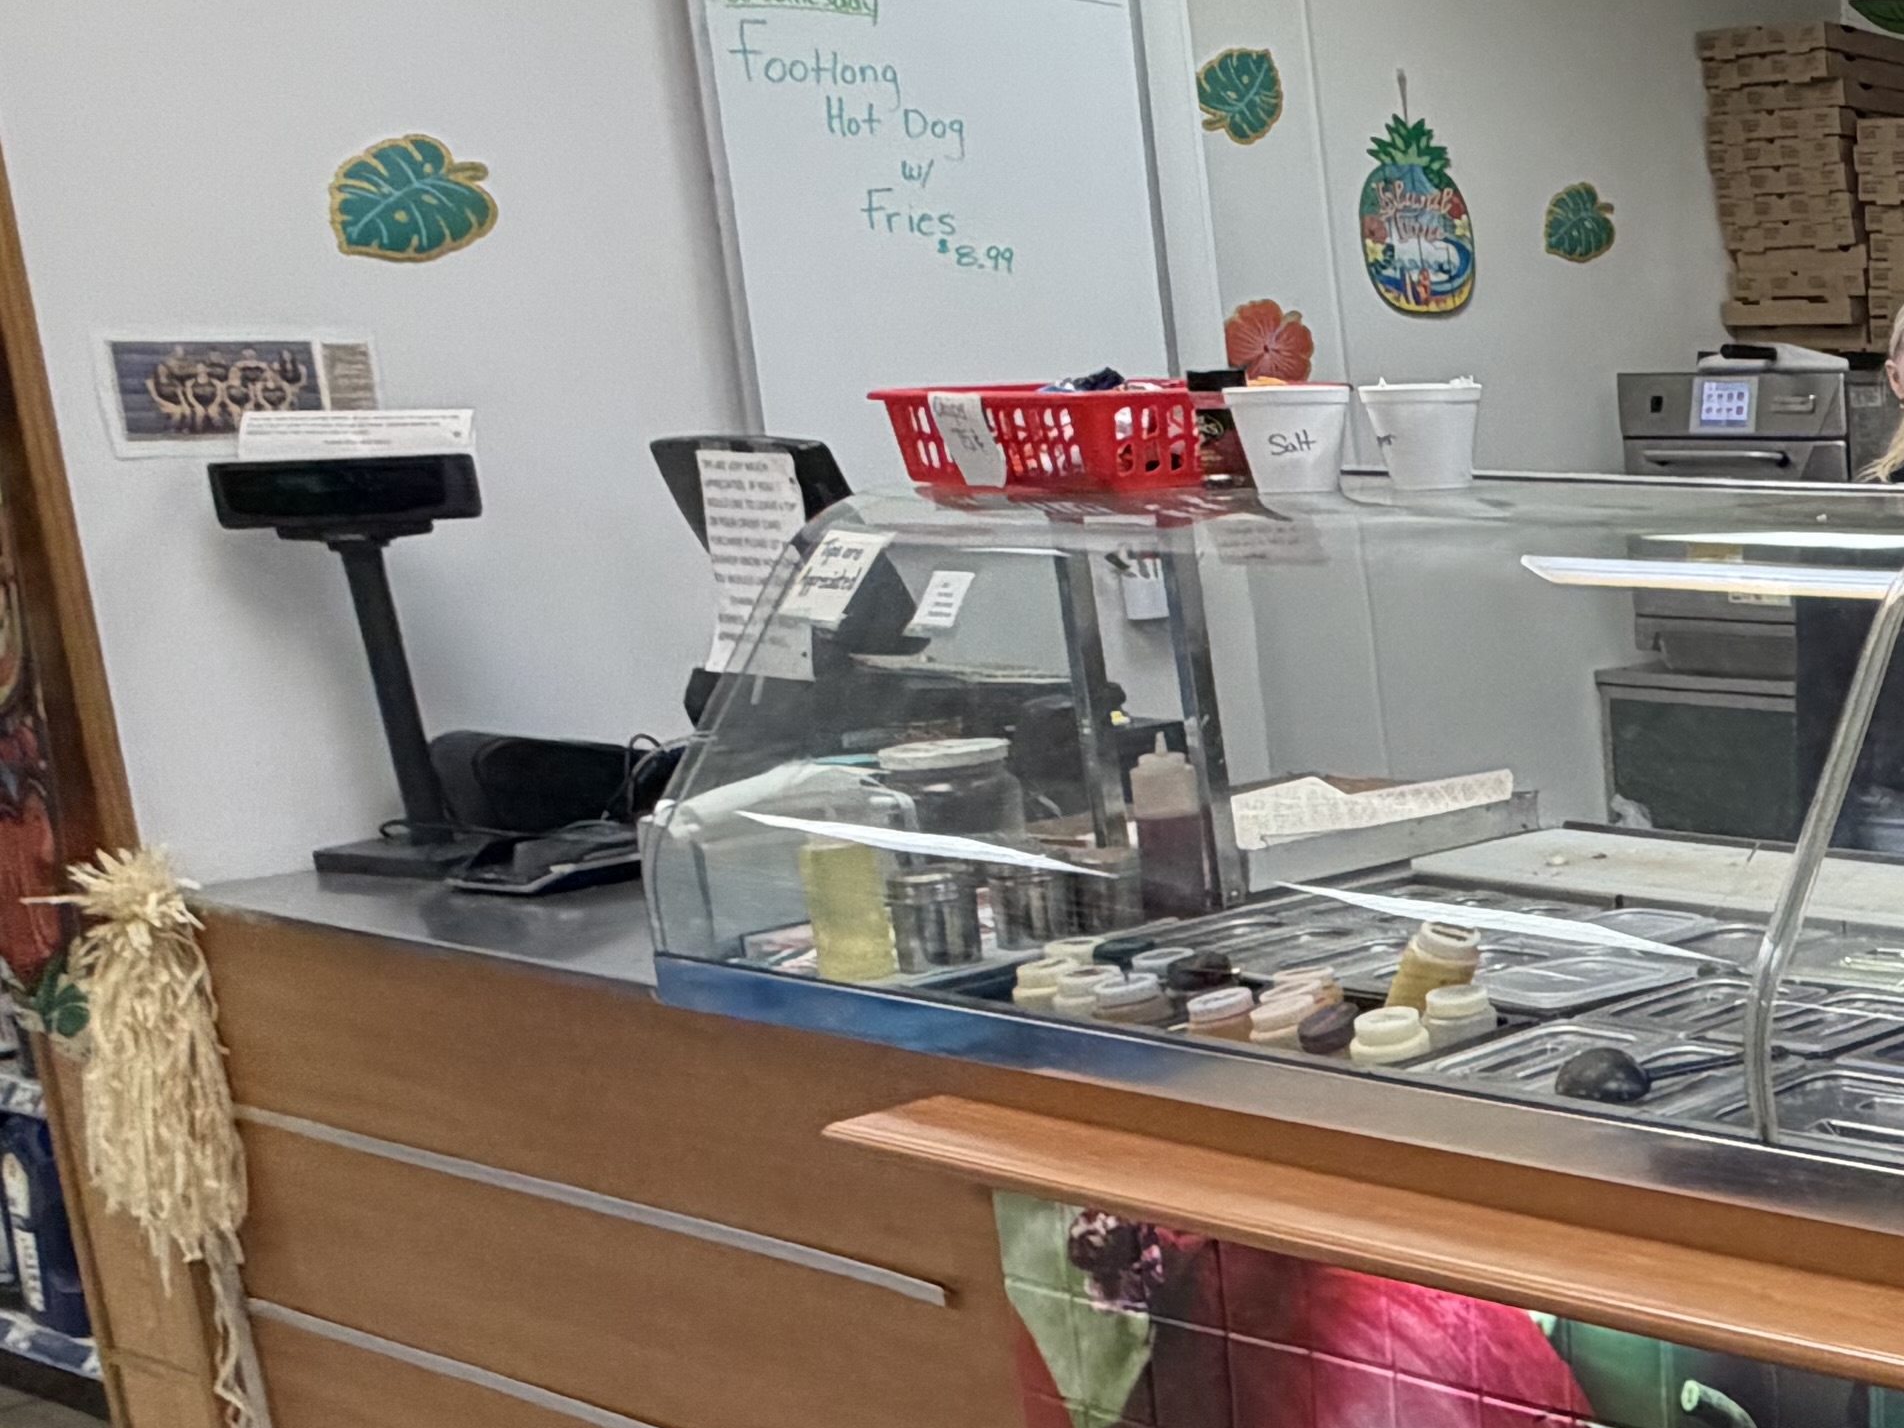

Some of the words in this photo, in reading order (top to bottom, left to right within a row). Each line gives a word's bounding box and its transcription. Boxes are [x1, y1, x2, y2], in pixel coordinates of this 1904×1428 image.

[826, 95, 882, 139] Hot
[903, 108, 965, 161] Dog
[861, 187, 956, 236] Fries
[1267, 429, 1318, 457] Salt
